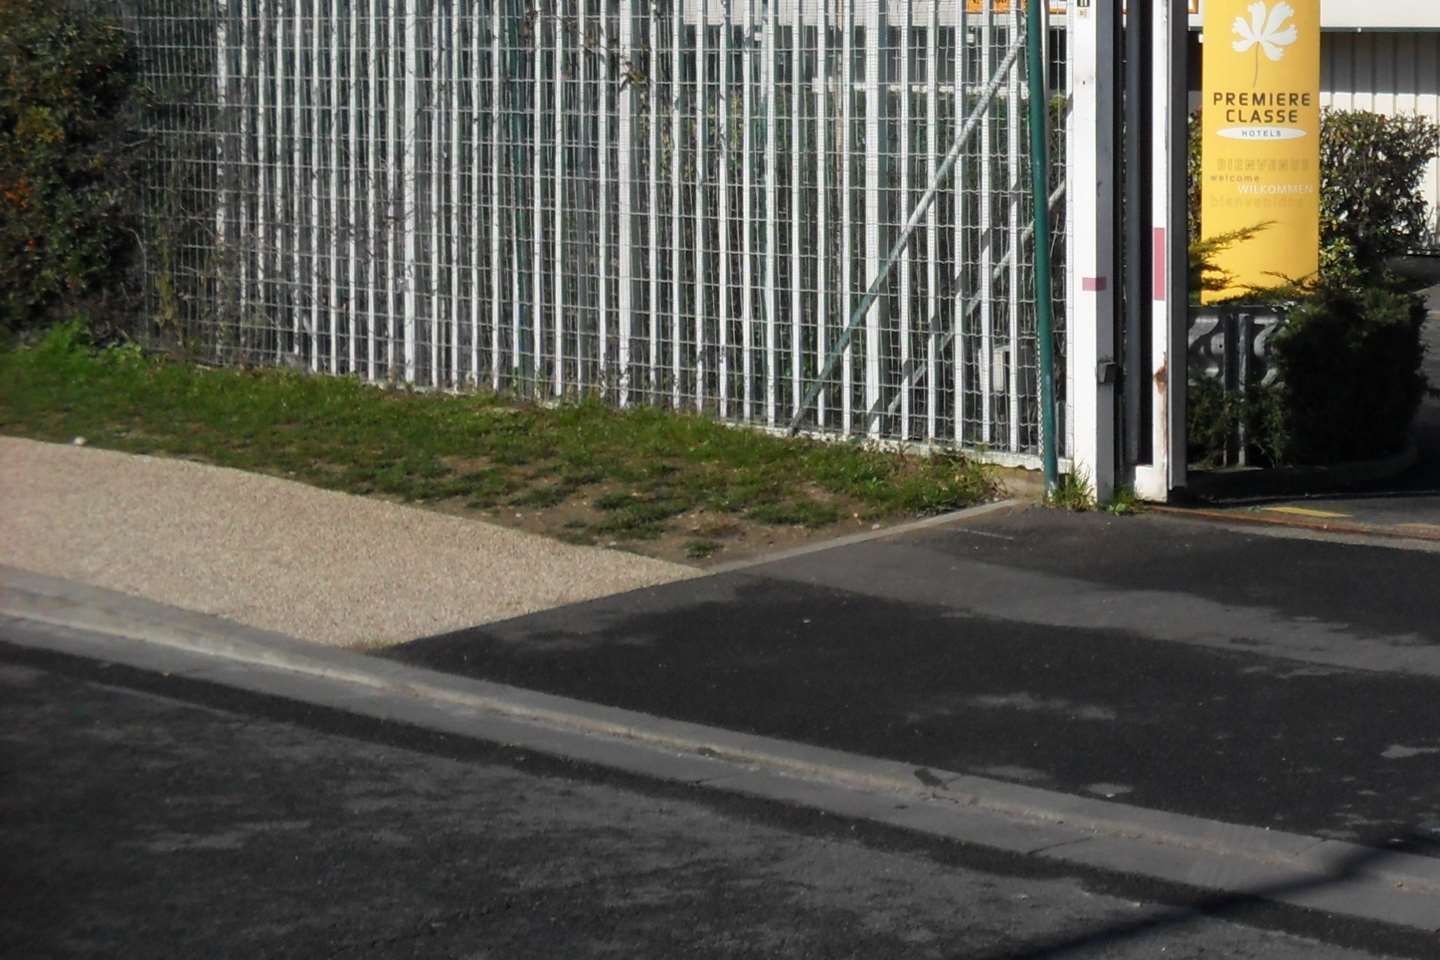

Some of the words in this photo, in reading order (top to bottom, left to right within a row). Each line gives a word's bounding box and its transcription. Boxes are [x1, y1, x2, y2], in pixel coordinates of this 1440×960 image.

[1212, 92, 1311, 107] PREMIERE
[1225, 109, 1299, 124] CLASSE
[1241, 129, 1282, 138] HOTELS
[1210, 174, 1261, 183] welcome
